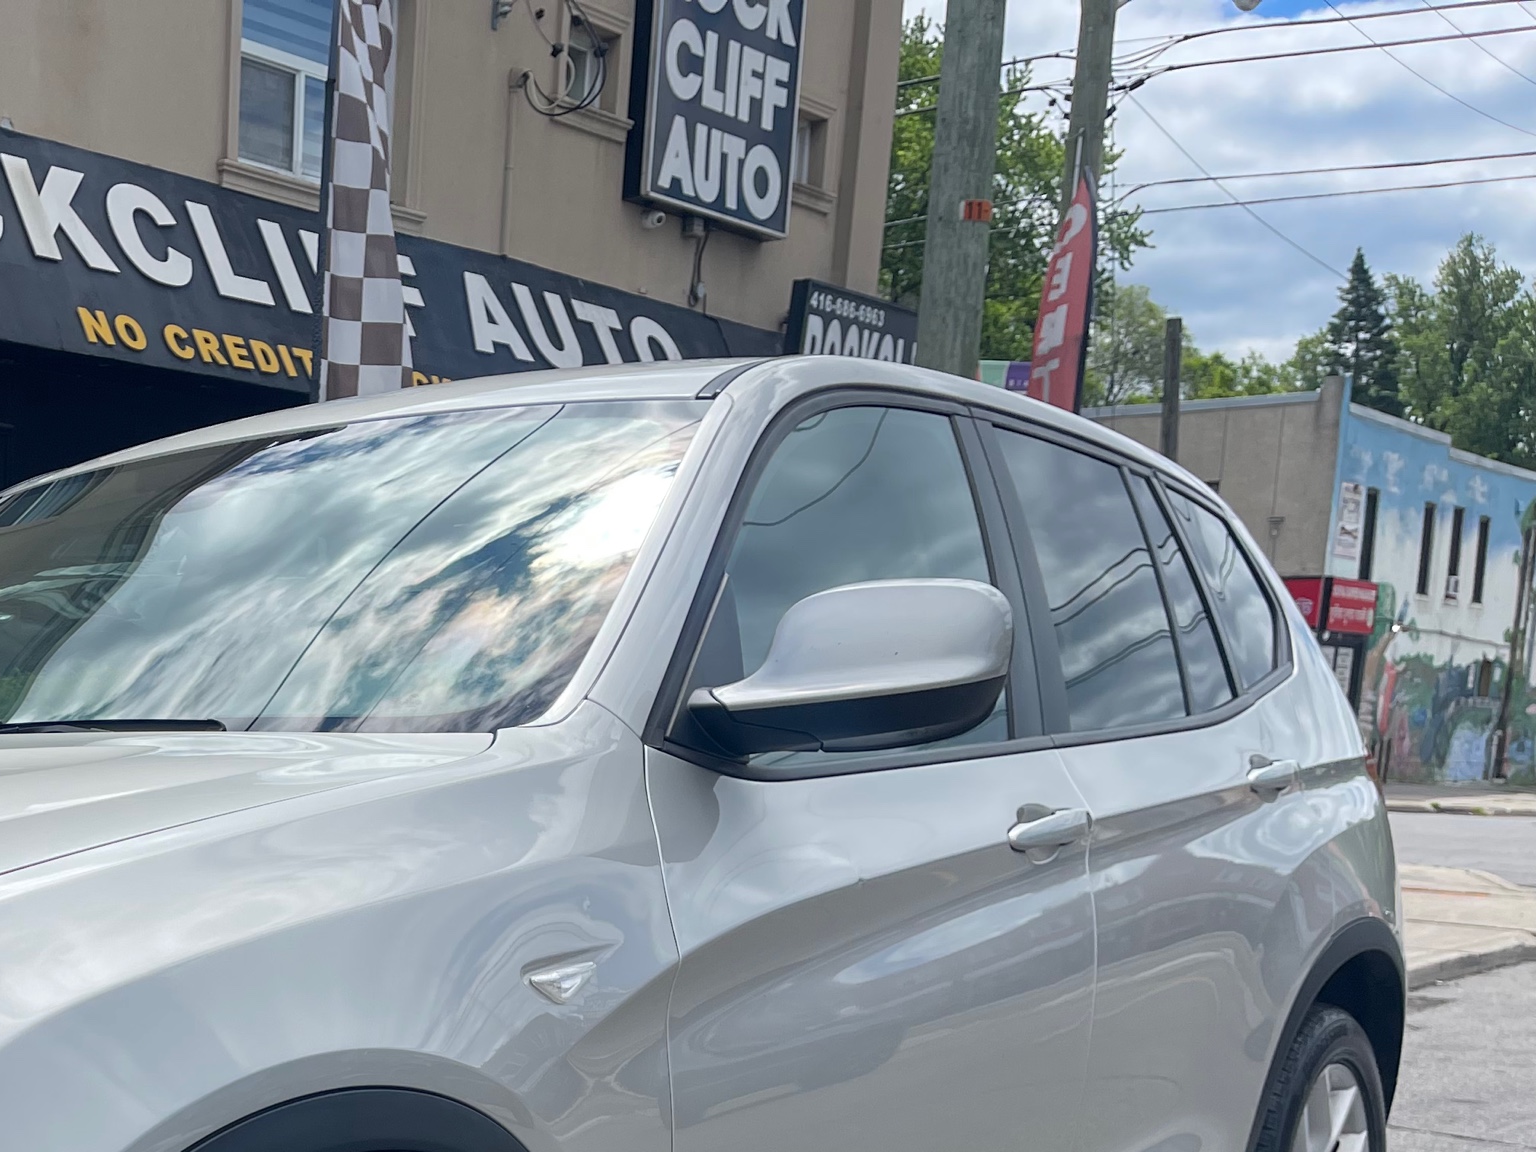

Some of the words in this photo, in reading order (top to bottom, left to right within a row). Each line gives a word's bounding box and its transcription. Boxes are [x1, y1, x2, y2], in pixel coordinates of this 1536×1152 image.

[665, 18, 791, 132] CLIFF
[657, 114, 782, 220] AUTO
[77, 307, 148, 352] NO
[164, 324, 313, 380] CREDIT
[463, 270, 683, 369] AUTO
